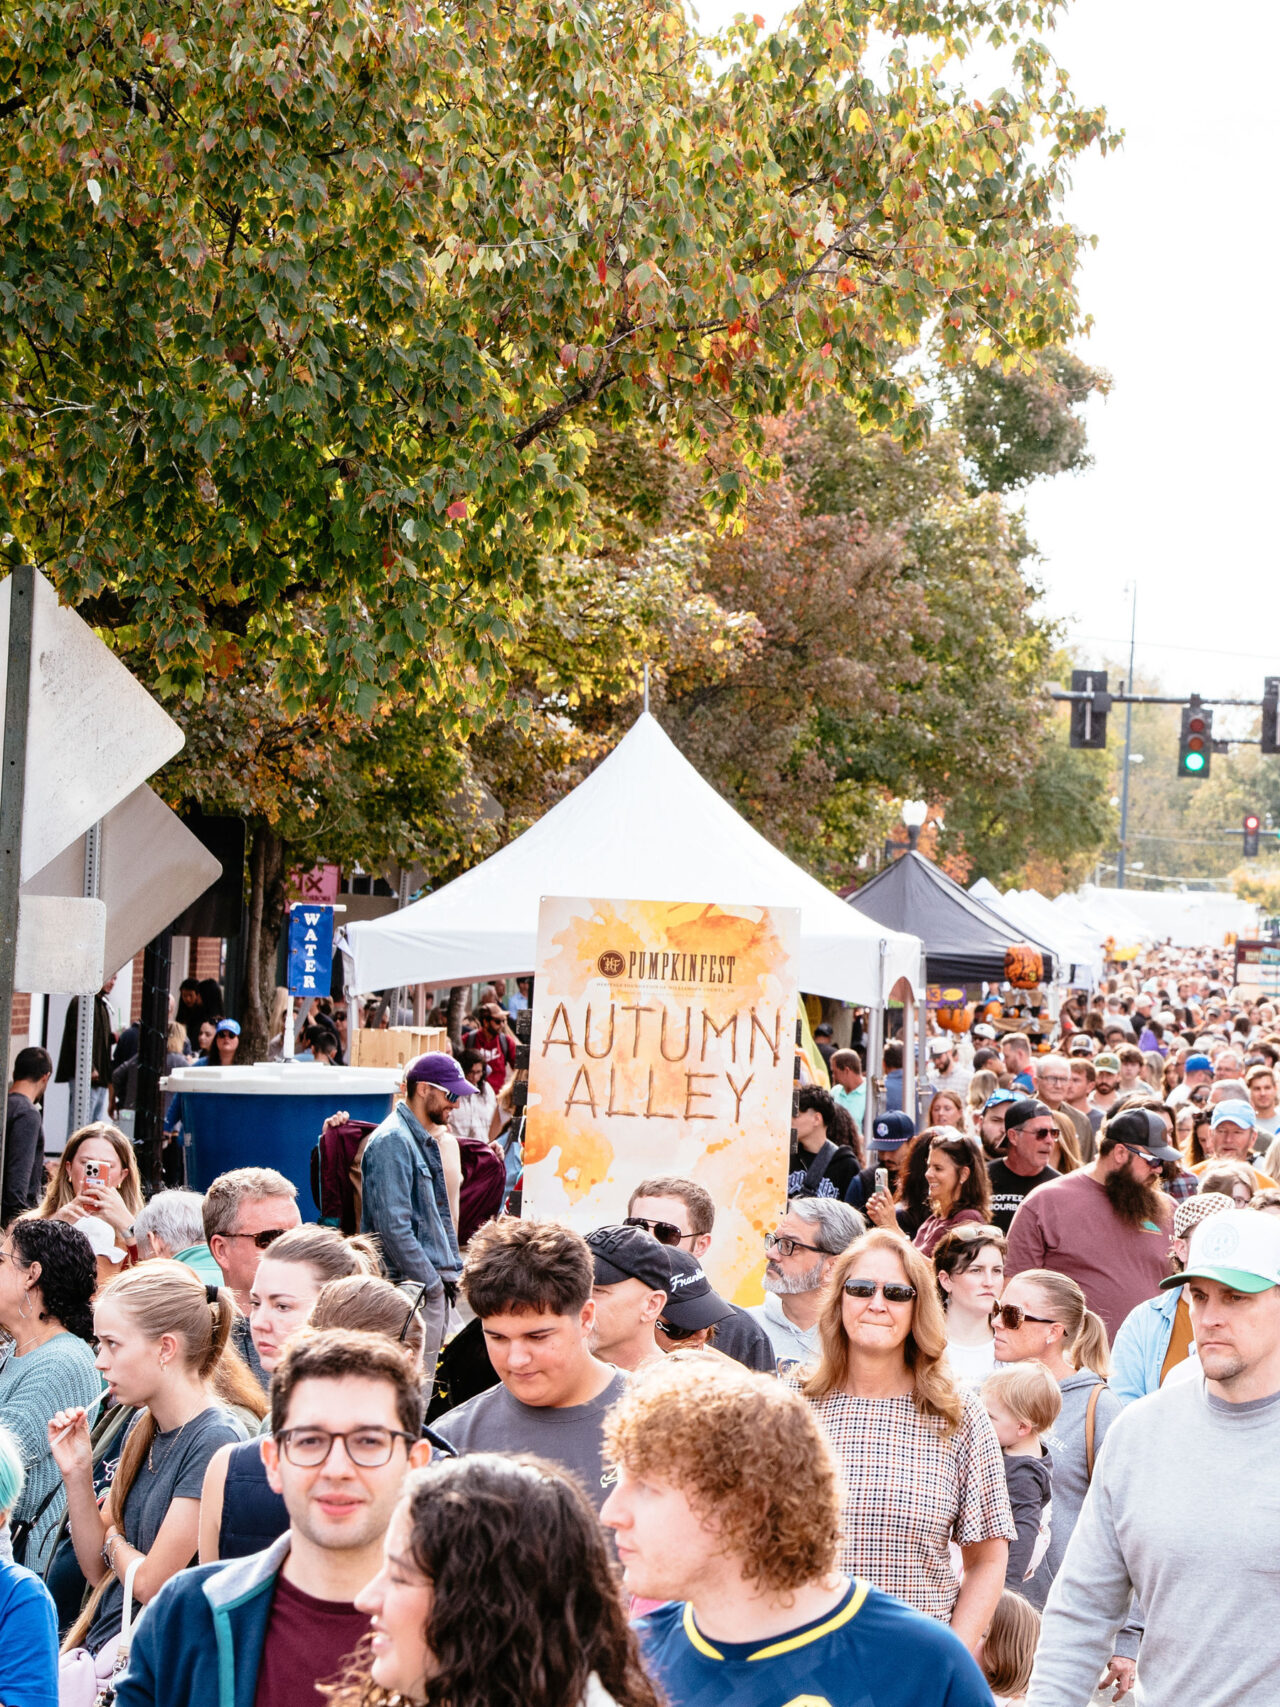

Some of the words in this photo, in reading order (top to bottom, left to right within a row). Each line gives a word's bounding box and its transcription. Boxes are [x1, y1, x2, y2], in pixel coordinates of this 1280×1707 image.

[303, 912, 321, 988] WATER
[628, 951, 736, 984] PUMPKINFEST
[542, 1001, 781, 1067] AUTUMN
[564, 1062, 755, 1123] ALLEY
